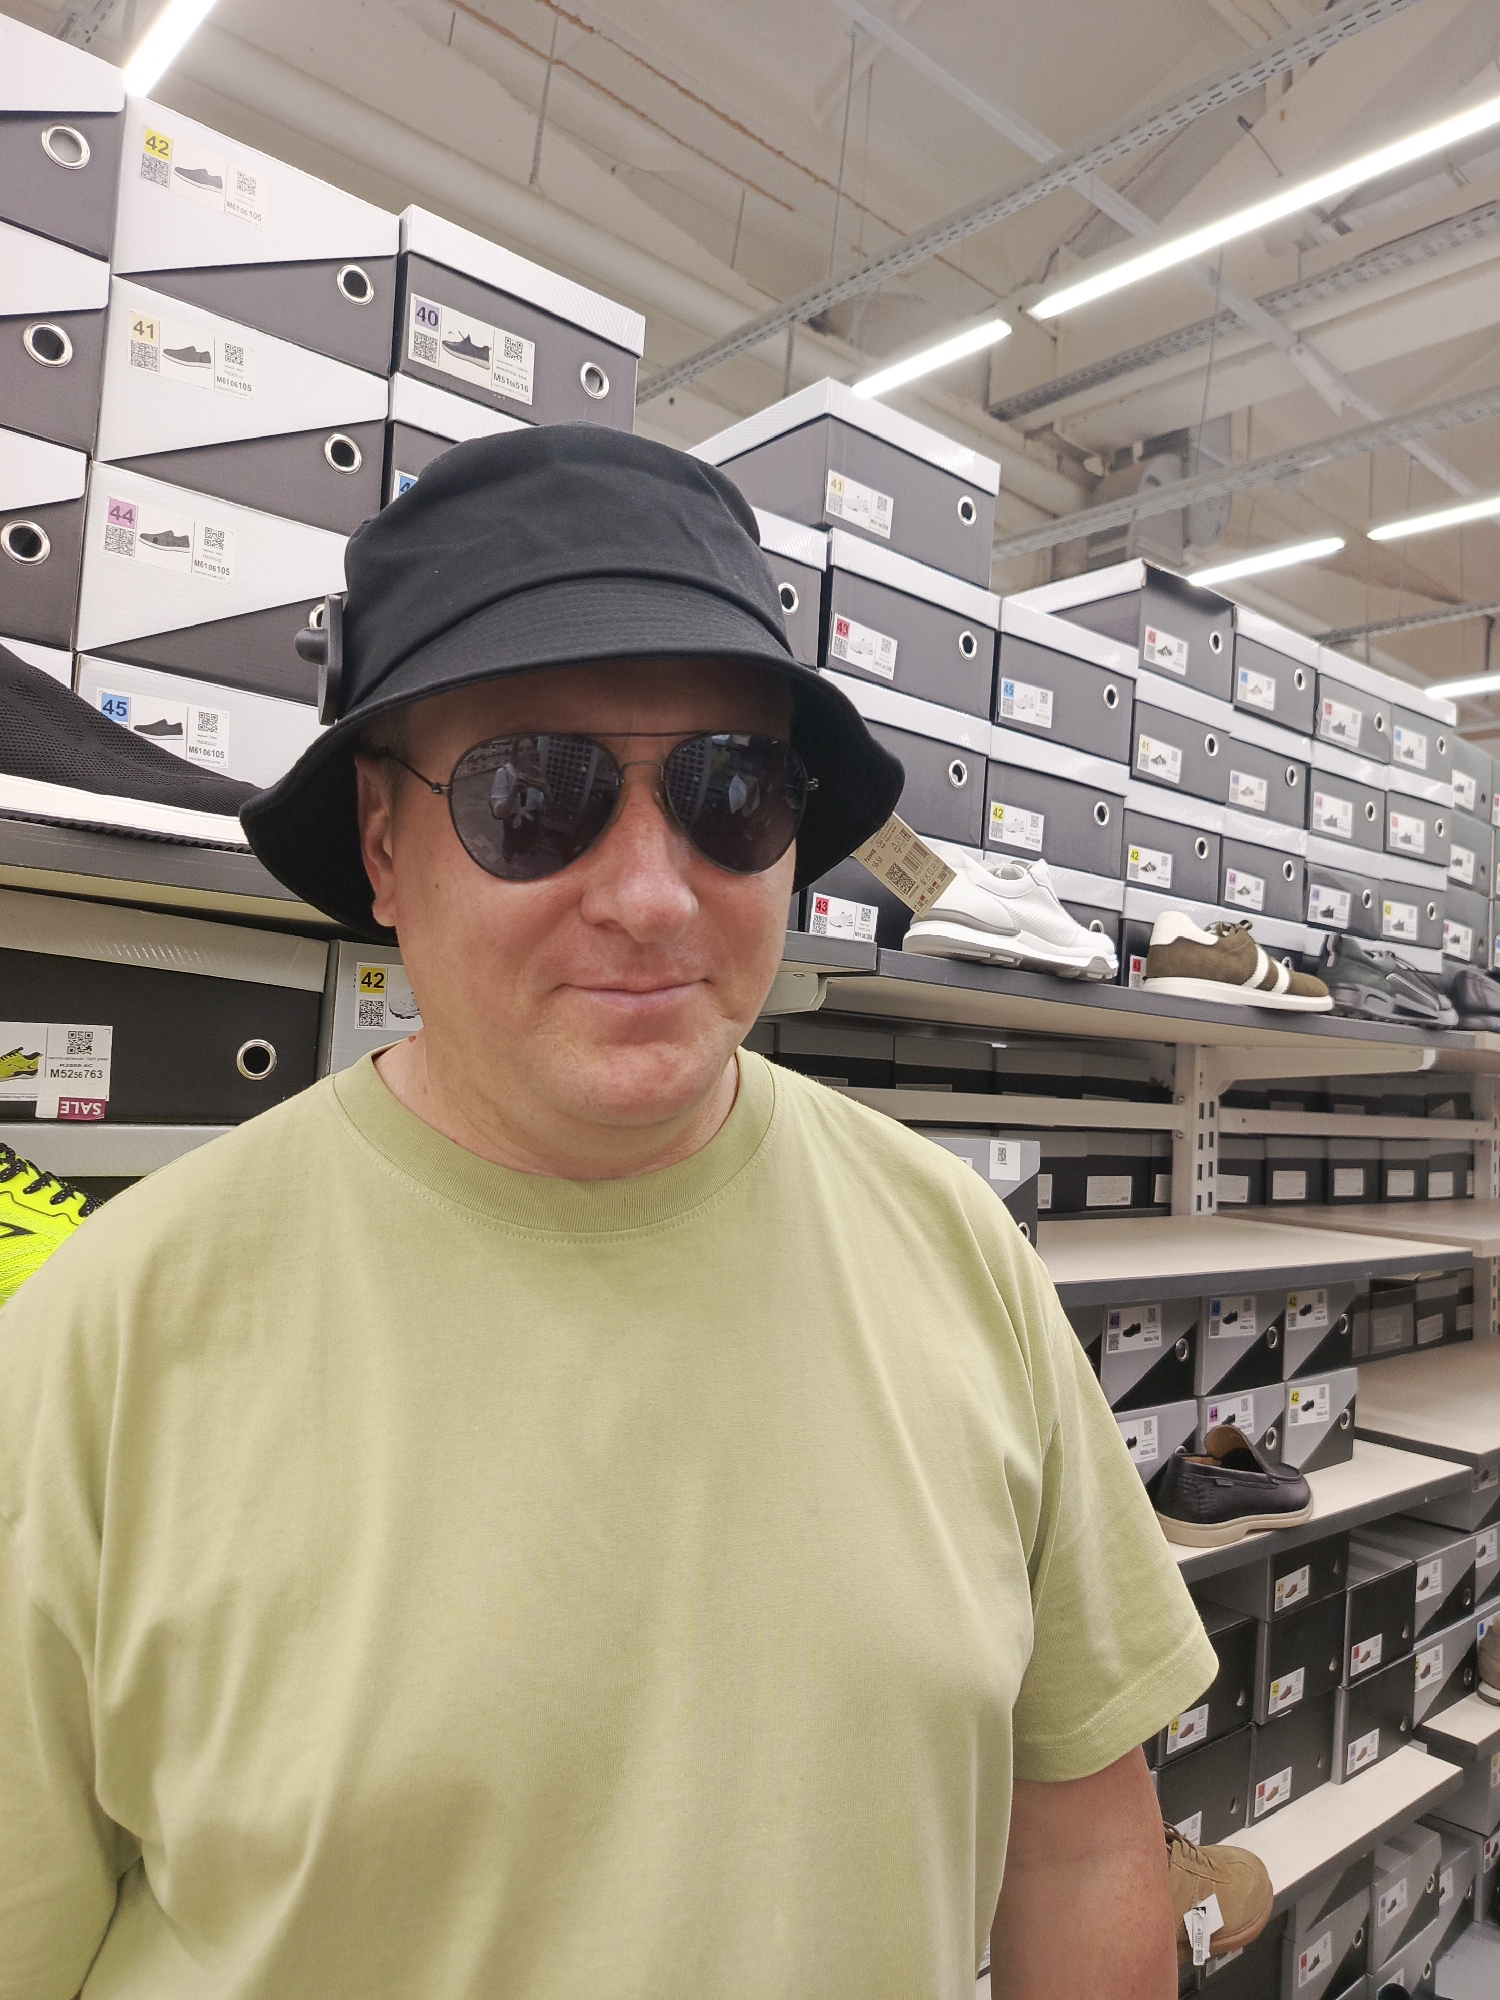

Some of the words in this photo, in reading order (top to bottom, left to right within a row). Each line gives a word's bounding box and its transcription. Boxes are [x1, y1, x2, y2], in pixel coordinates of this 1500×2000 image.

[146, 136, 169, 156] 42
[226, 201, 262, 221] M6106105
[416, 306, 439, 326] 40
[133, 320, 154, 339] 41
[216, 376, 252, 392] M6106105
[831, 479, 842, 492] 41
[109, 506, 134, 524] 44
[194, 559, 230, 576] M6106105
[837, 622, 849, 636] 43
[1004, 684, 1014, 696] 45
[102, 700, 128, 716] 45
[188, 746, 224, 758] M6106105
[1142, 740, 1150, 751] 41
[993, 808, 1004, 820] 42
[1131, 849, 1138, 861] 42
[816, 900, 828, 912] 43
[361, 972, 384, 988] 42
[50, 1068, 103, 1078] M5256763
[60, 1101, 102, 1116] SALE
[1291, 1392, 1300, 1402] 42
[1209, 1408, 1218, 1419] 44
